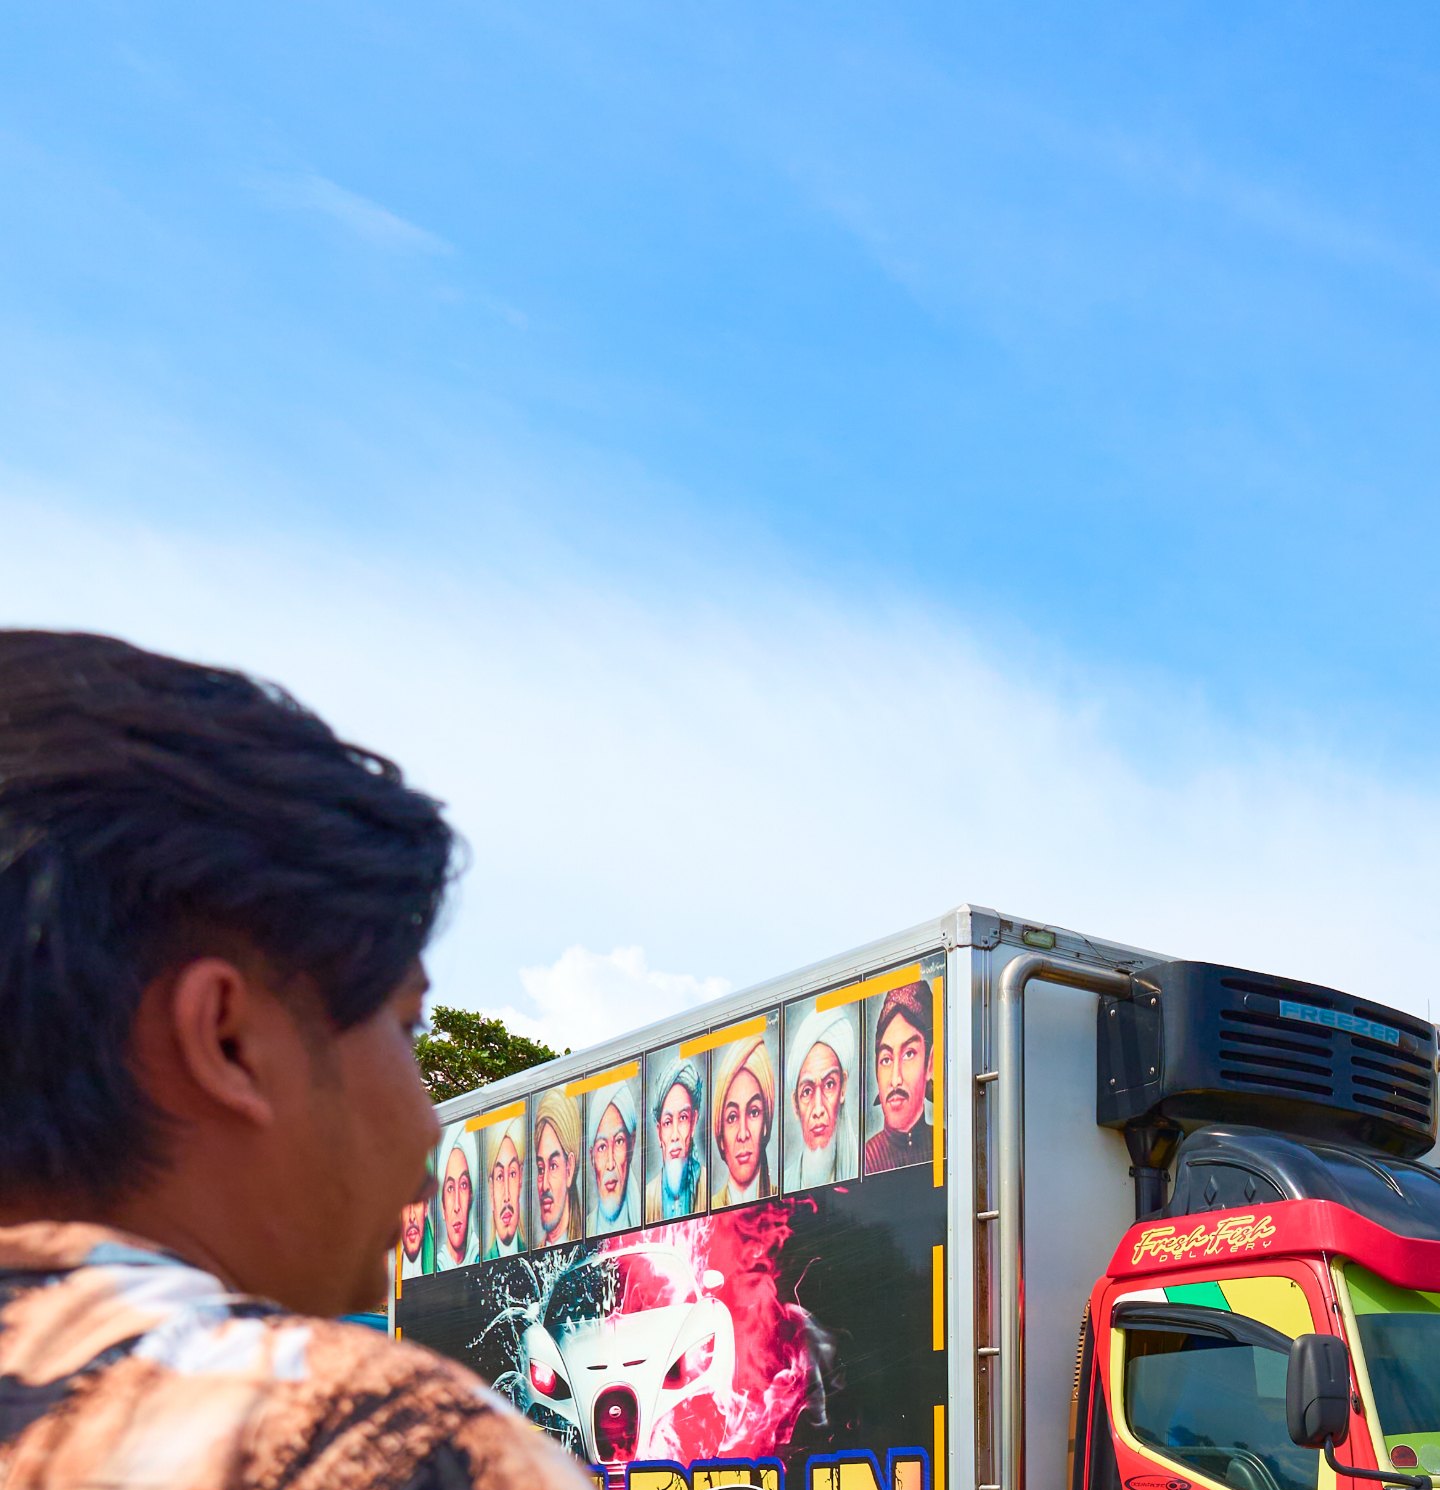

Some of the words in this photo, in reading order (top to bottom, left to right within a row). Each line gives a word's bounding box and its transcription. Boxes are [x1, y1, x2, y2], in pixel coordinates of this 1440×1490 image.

[1282, 1001, 1398, 1042] FREEZER
[1131, 1225, 1209, 1264] Fresh
[1204, 1215, 1276, 1254] Fish
[1159, 1240, 1272, 1262] DELIVERY
